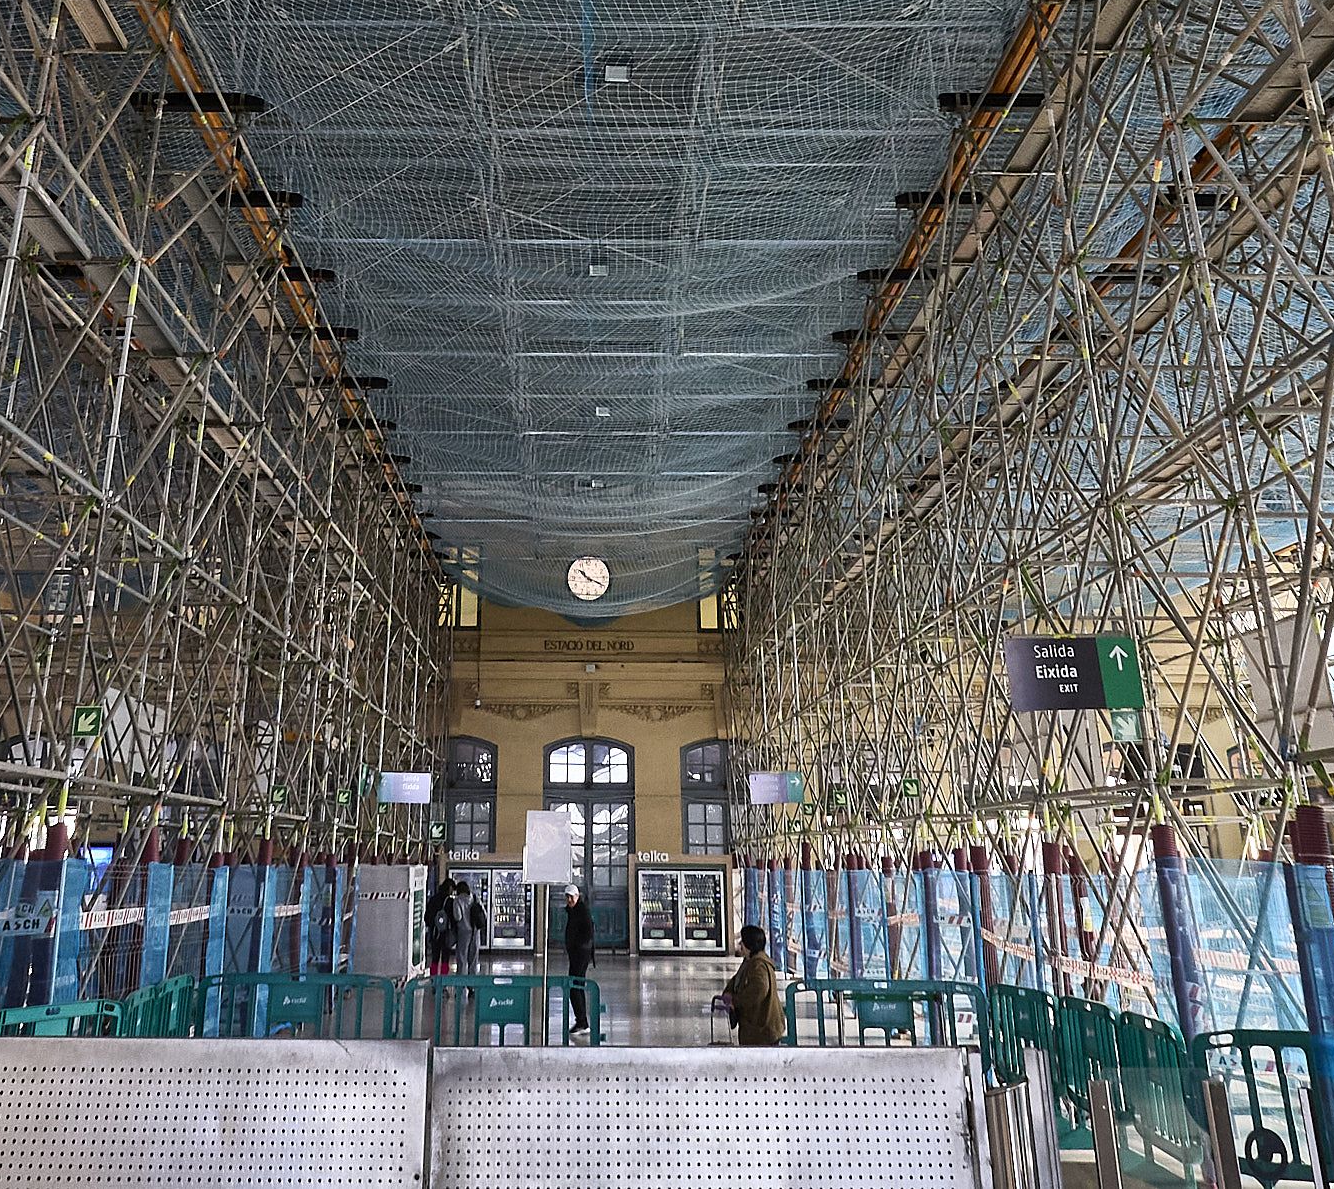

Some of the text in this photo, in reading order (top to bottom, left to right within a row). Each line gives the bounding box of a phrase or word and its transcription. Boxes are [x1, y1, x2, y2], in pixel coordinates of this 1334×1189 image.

[586, 640, 605, 651] DEL
[607, 640, 635, 651] NORD
[1034, 645, 1075, 659] Salida
[1036, 665, 1078, 679] Eixida
[1059, 684, 1079, 693] EXIT
[1, 918, 40, 931] ASCH
